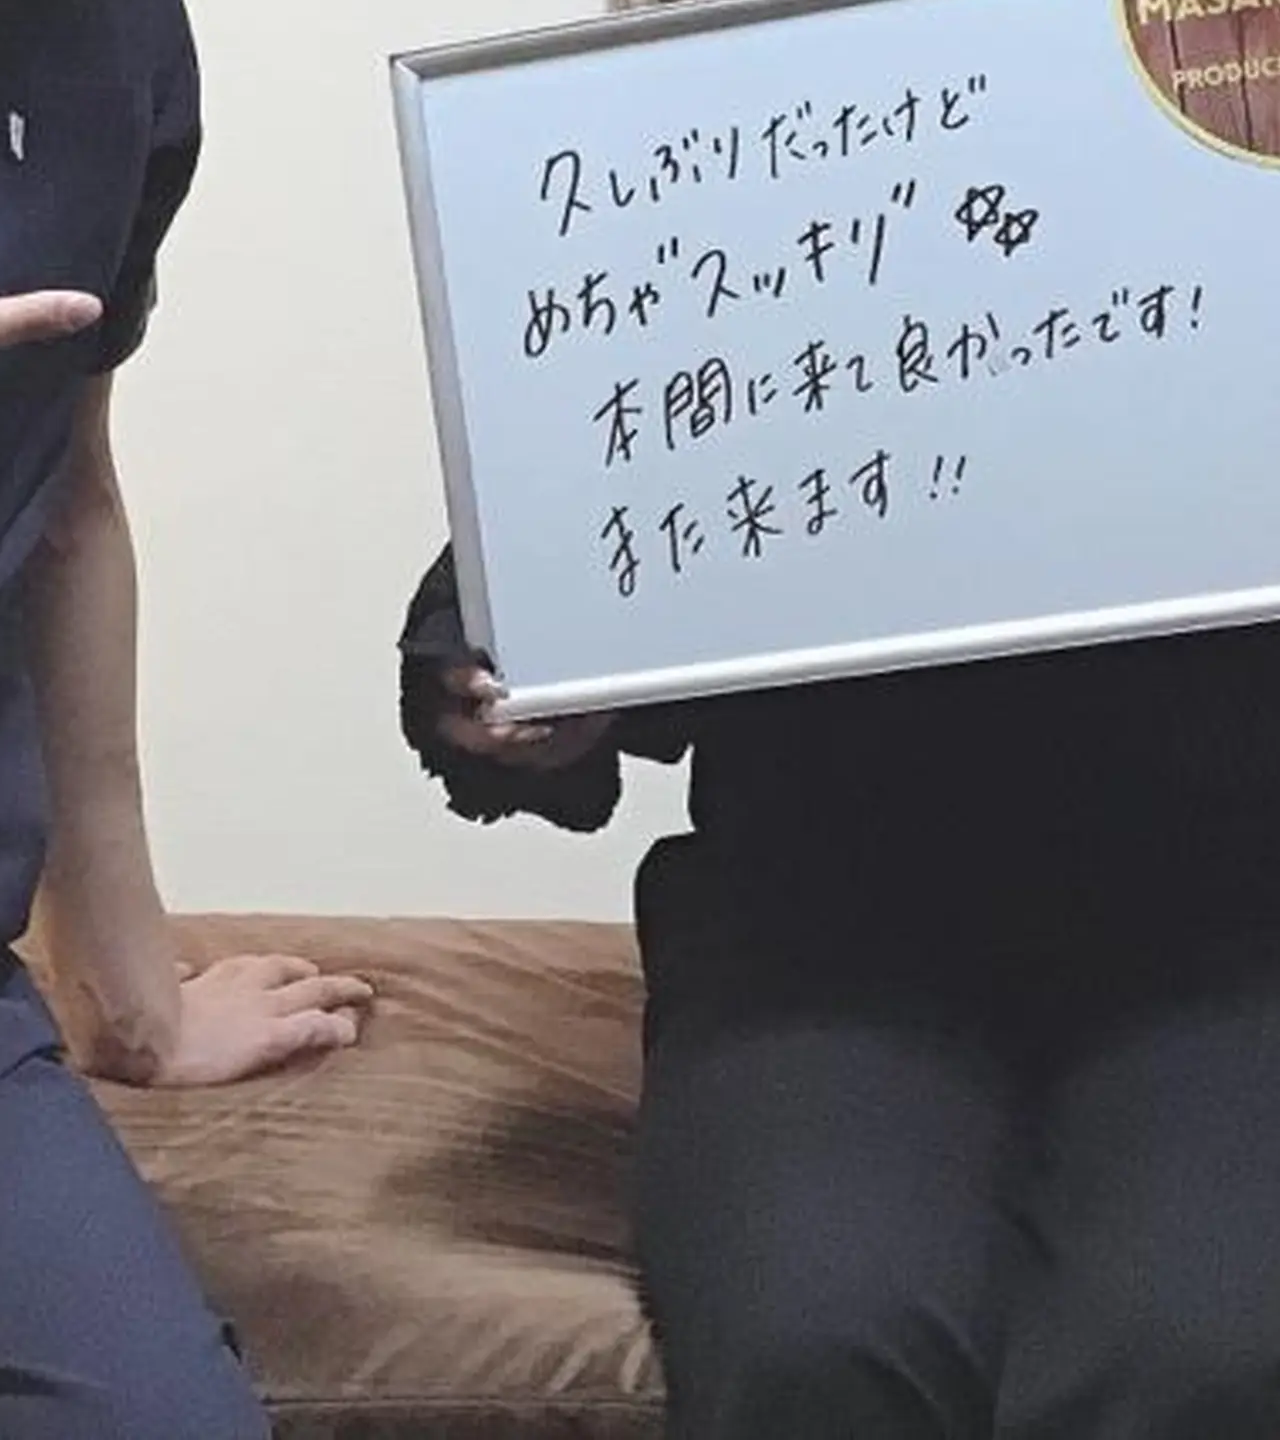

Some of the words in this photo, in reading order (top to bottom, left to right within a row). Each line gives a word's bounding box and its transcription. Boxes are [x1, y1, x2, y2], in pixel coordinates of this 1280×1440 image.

[540, 73, 987, 237] 久しぶりだったけど
